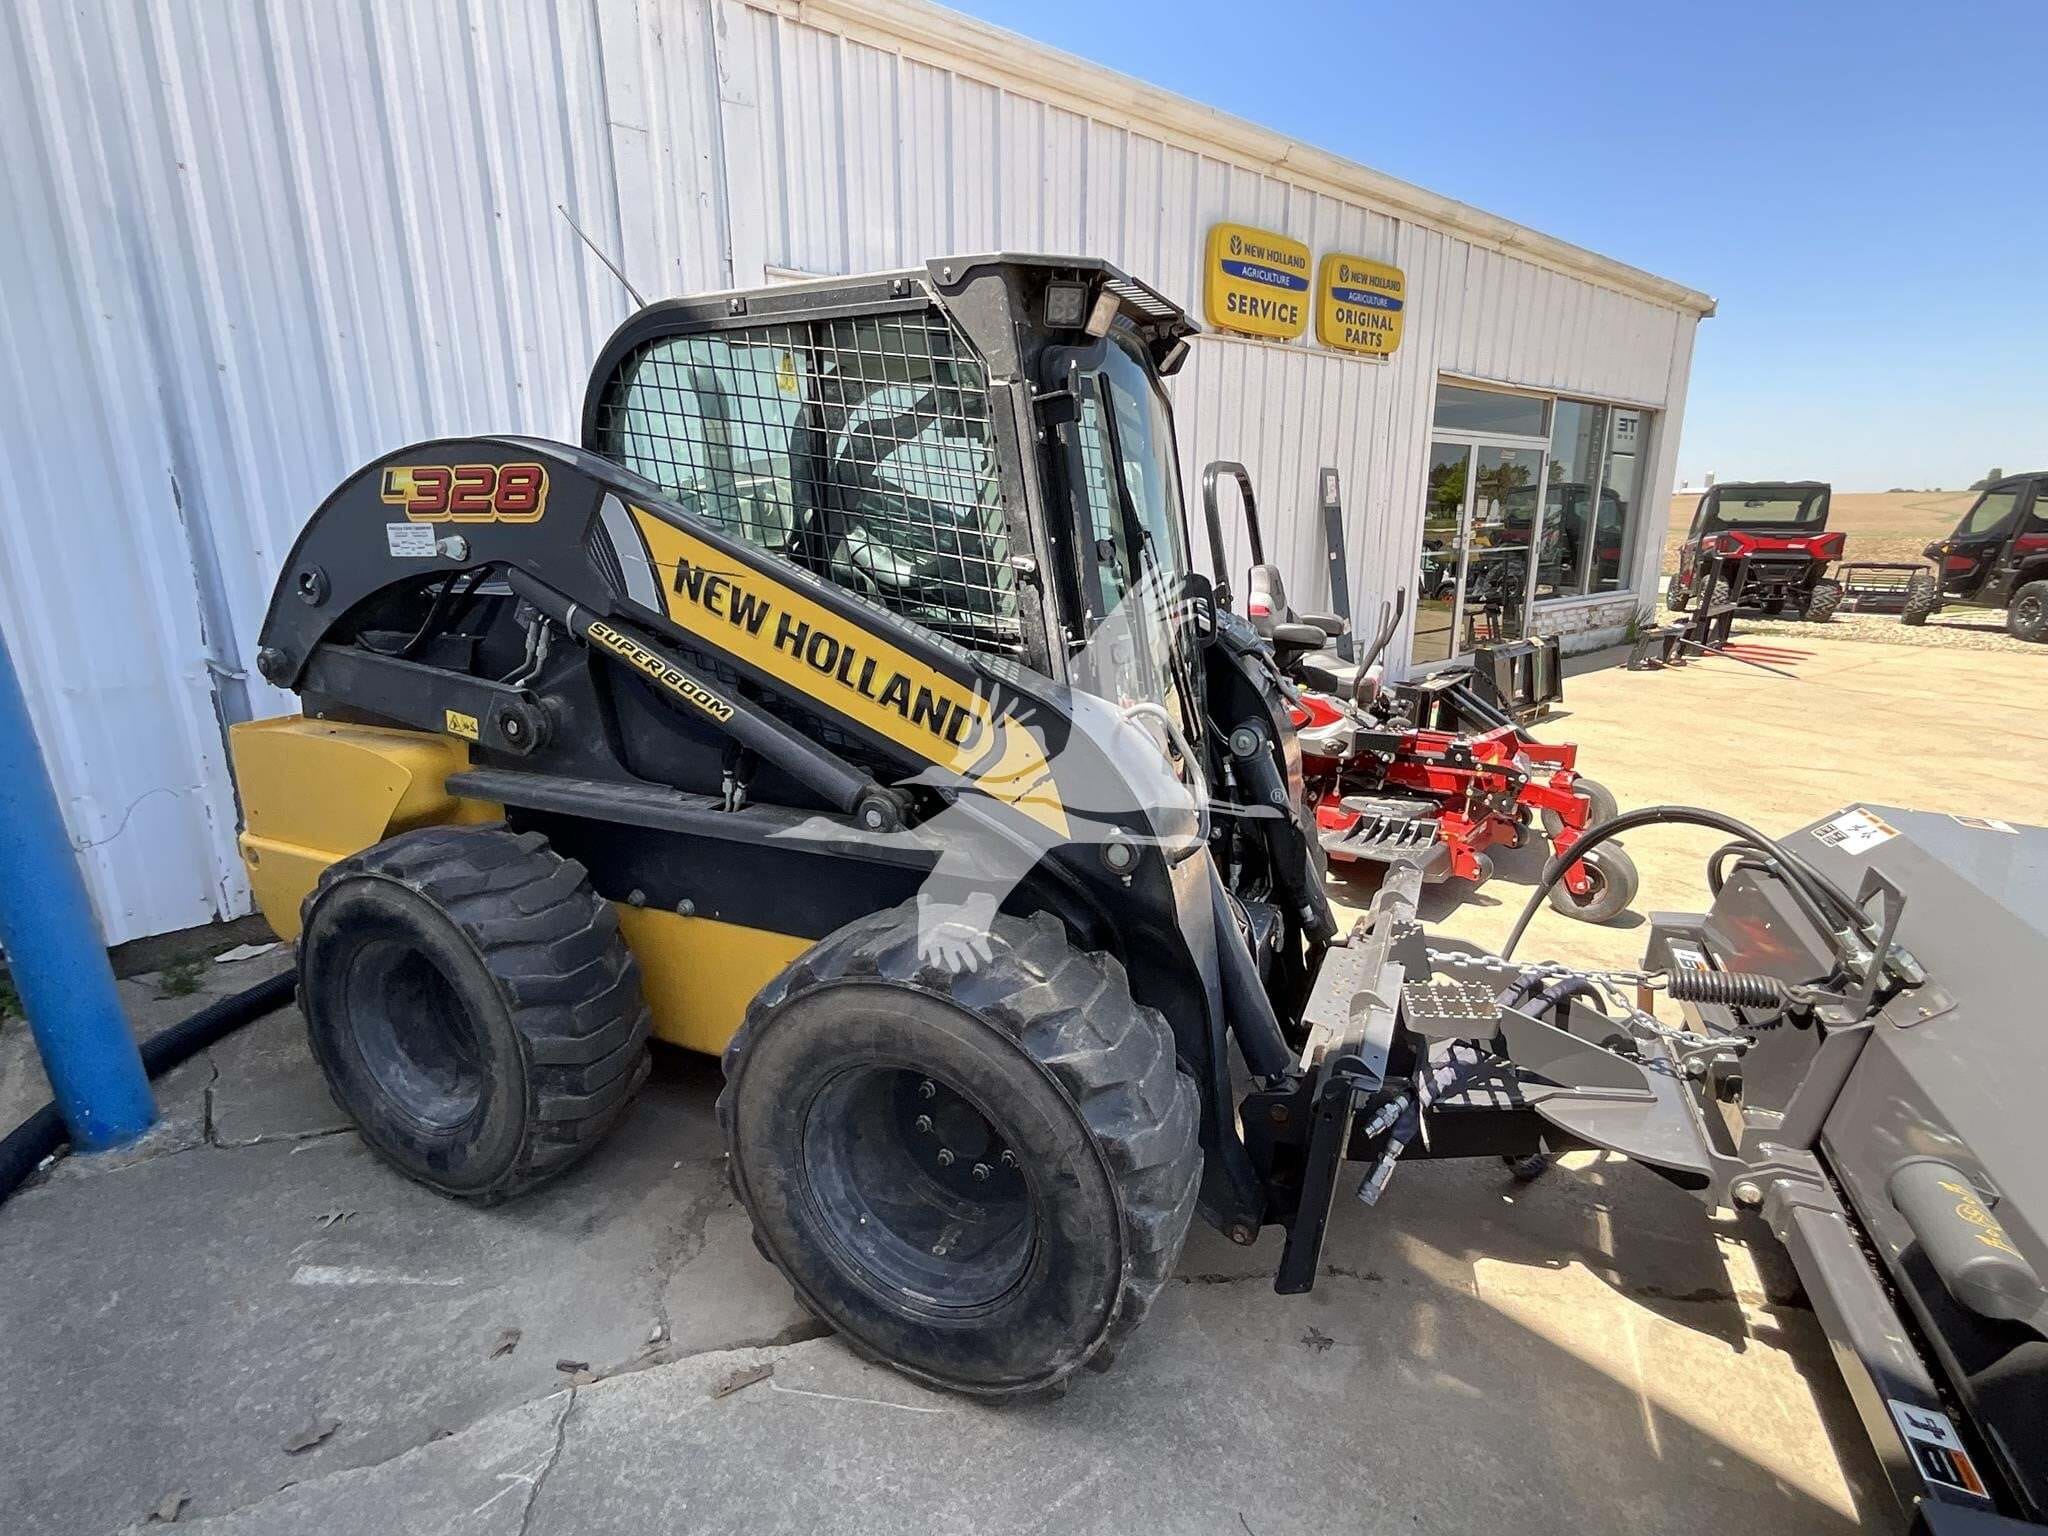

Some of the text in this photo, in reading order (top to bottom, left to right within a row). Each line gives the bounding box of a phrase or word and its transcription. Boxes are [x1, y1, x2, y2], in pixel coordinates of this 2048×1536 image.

[1244, 243, 1306, 269] NEW HOLLAND
[1241, 265, 1291, 286] AGRICULTURE
[1350, 270, 1401, 292] NEW HOLLAND
[1227, 292, 1298, 326] SERVICE
[1347, 291, 1388, 307] AGRICULTURE
[1335, 307, 1394, 332] ORIGINAL
[1345, 327, 1383, 348] PARTS
[381, 463, 549, 523] L328
[673, 557, 985, 748] NEW HOLLAND
